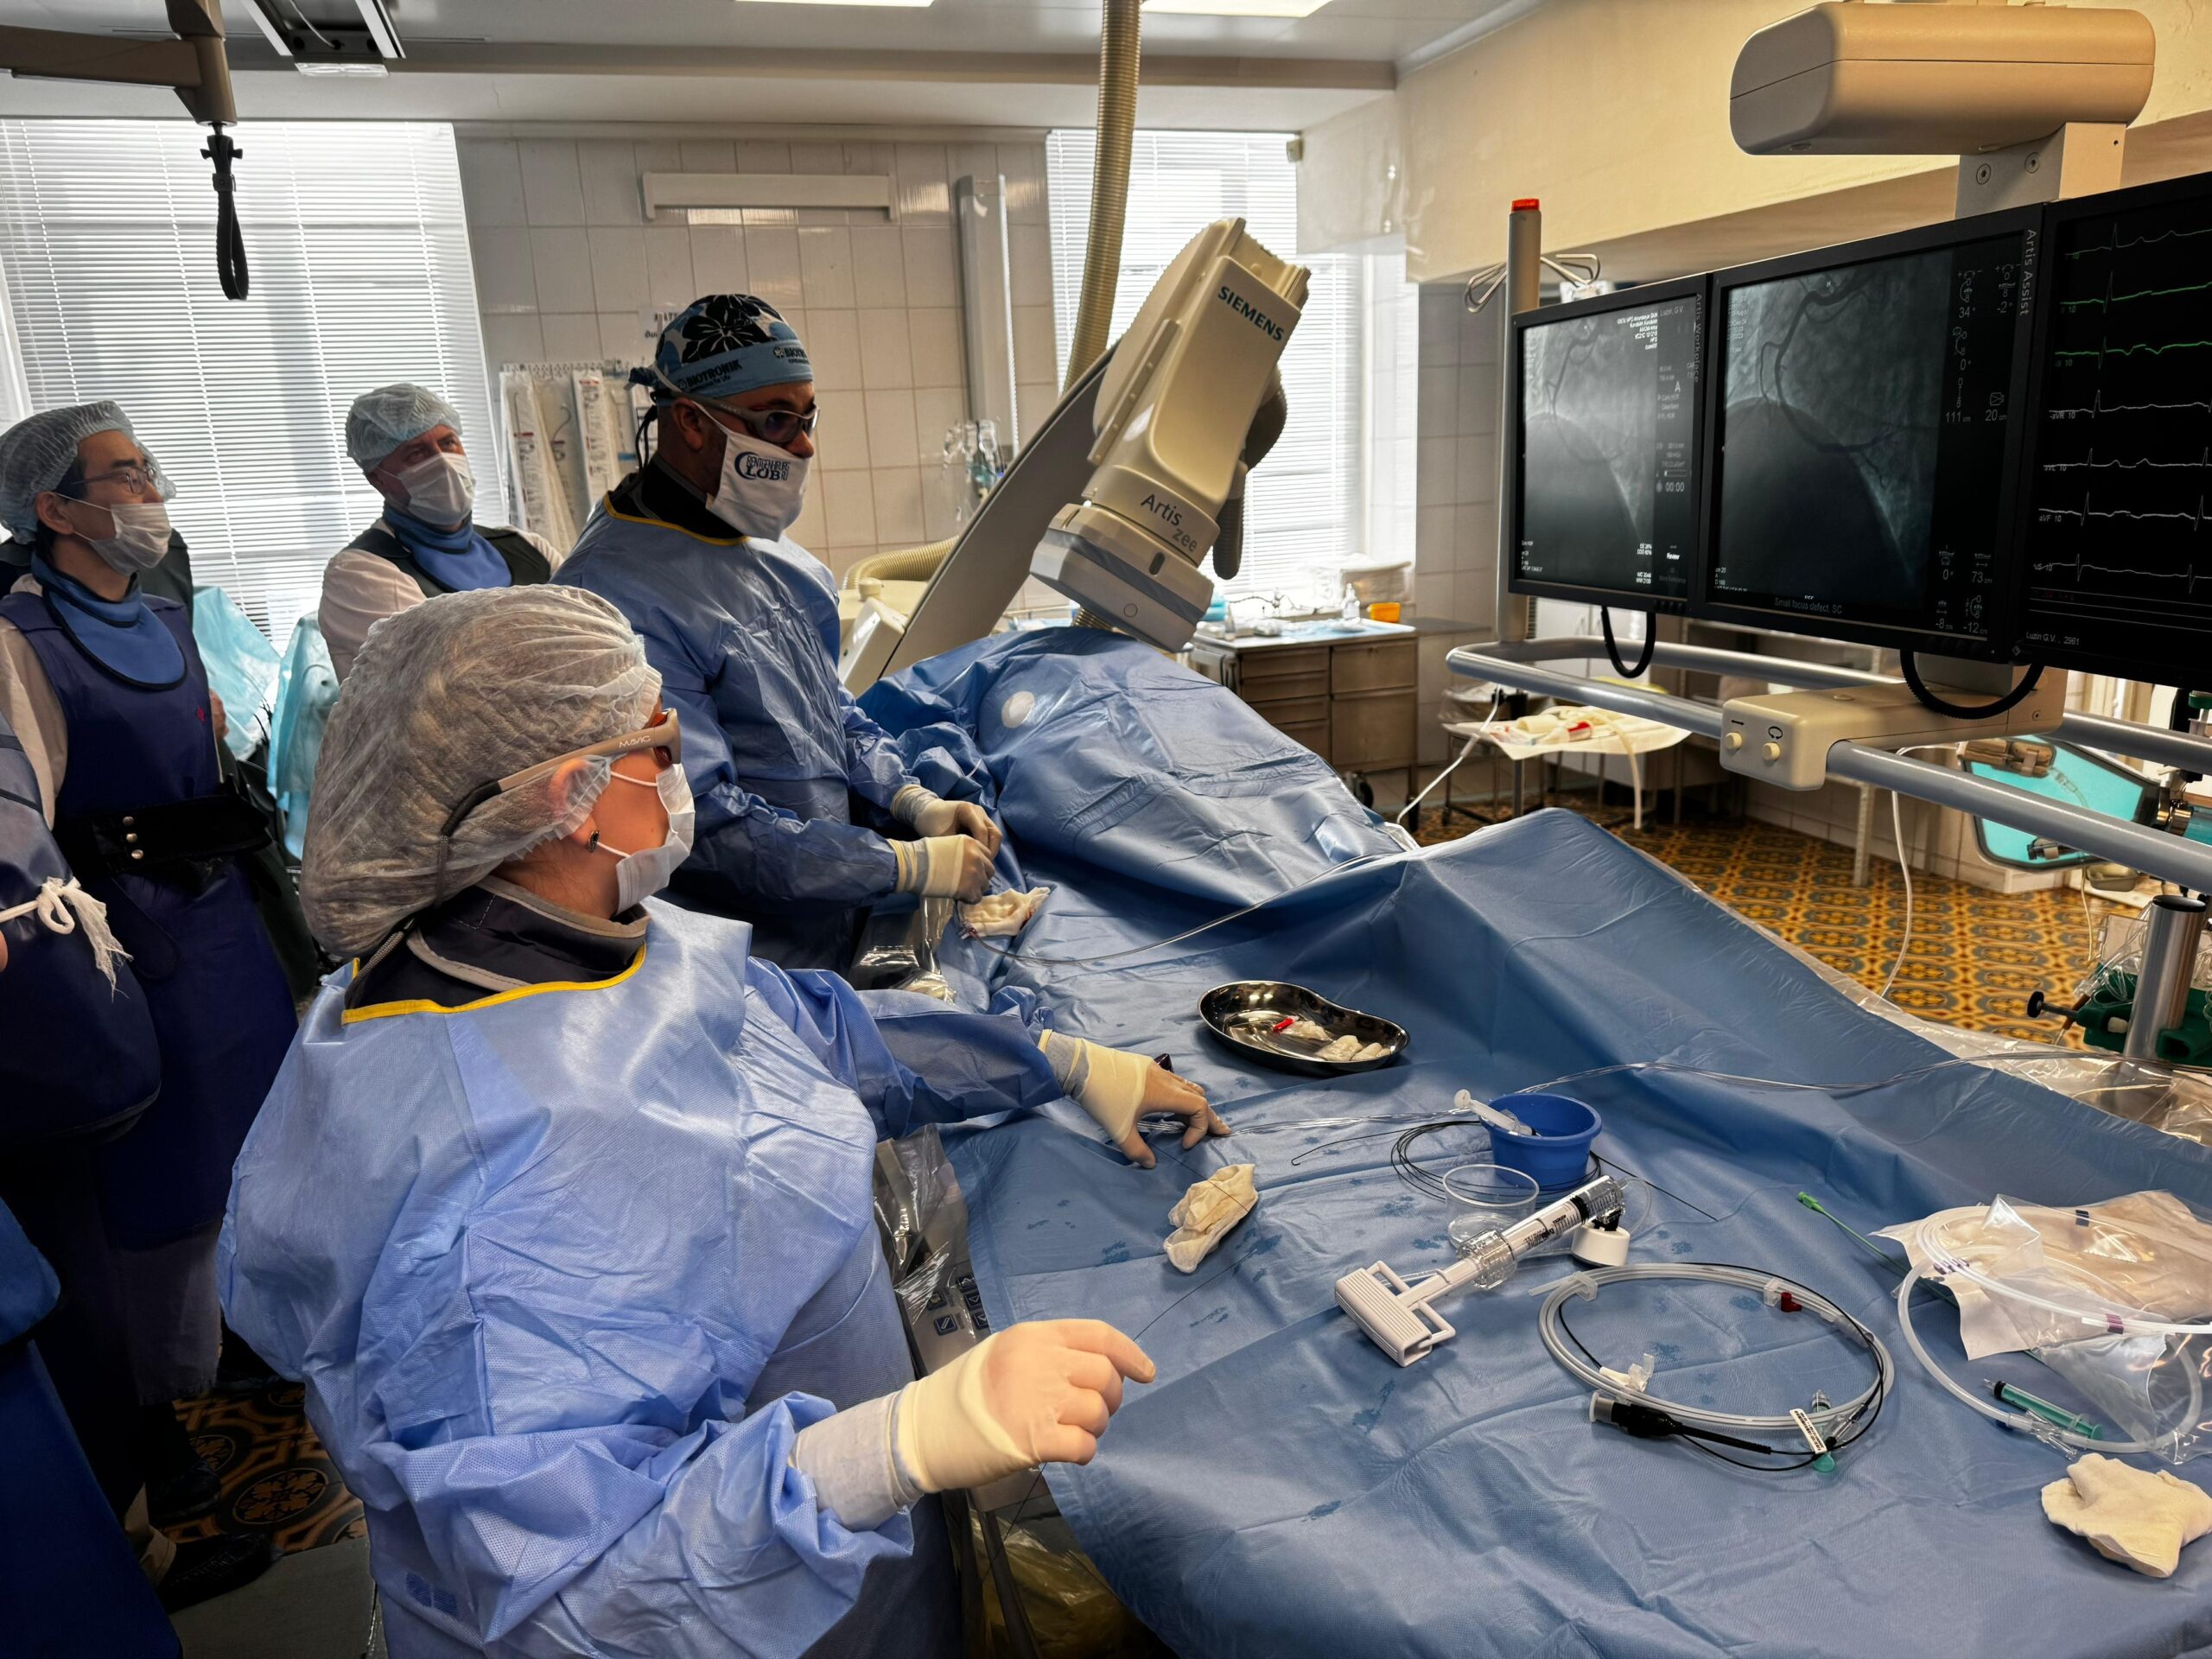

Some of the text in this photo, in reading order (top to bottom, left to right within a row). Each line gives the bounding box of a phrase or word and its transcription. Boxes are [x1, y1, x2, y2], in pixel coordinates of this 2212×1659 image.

[2019, 229, 2037, 315] Artis Assist
[1217, 286, 1285, 341] SIEMENS
[686, 359, 743, 388] BIOTRONIK
[1675, 380, 1681, 393] A
[1946, 411, 1961, 422] 111
[1986, 409, 1998, 422] 20
[1666, 481, 1685, 493] 00:00
[1141, 493, 1198, 552] Artis zee
[1972, 571, 1983, 583] 73
[1775, 598, 1790, 607] Small
[1792, 600, 1808, 609] focus
[1832, 604, 1842, 614] SC
